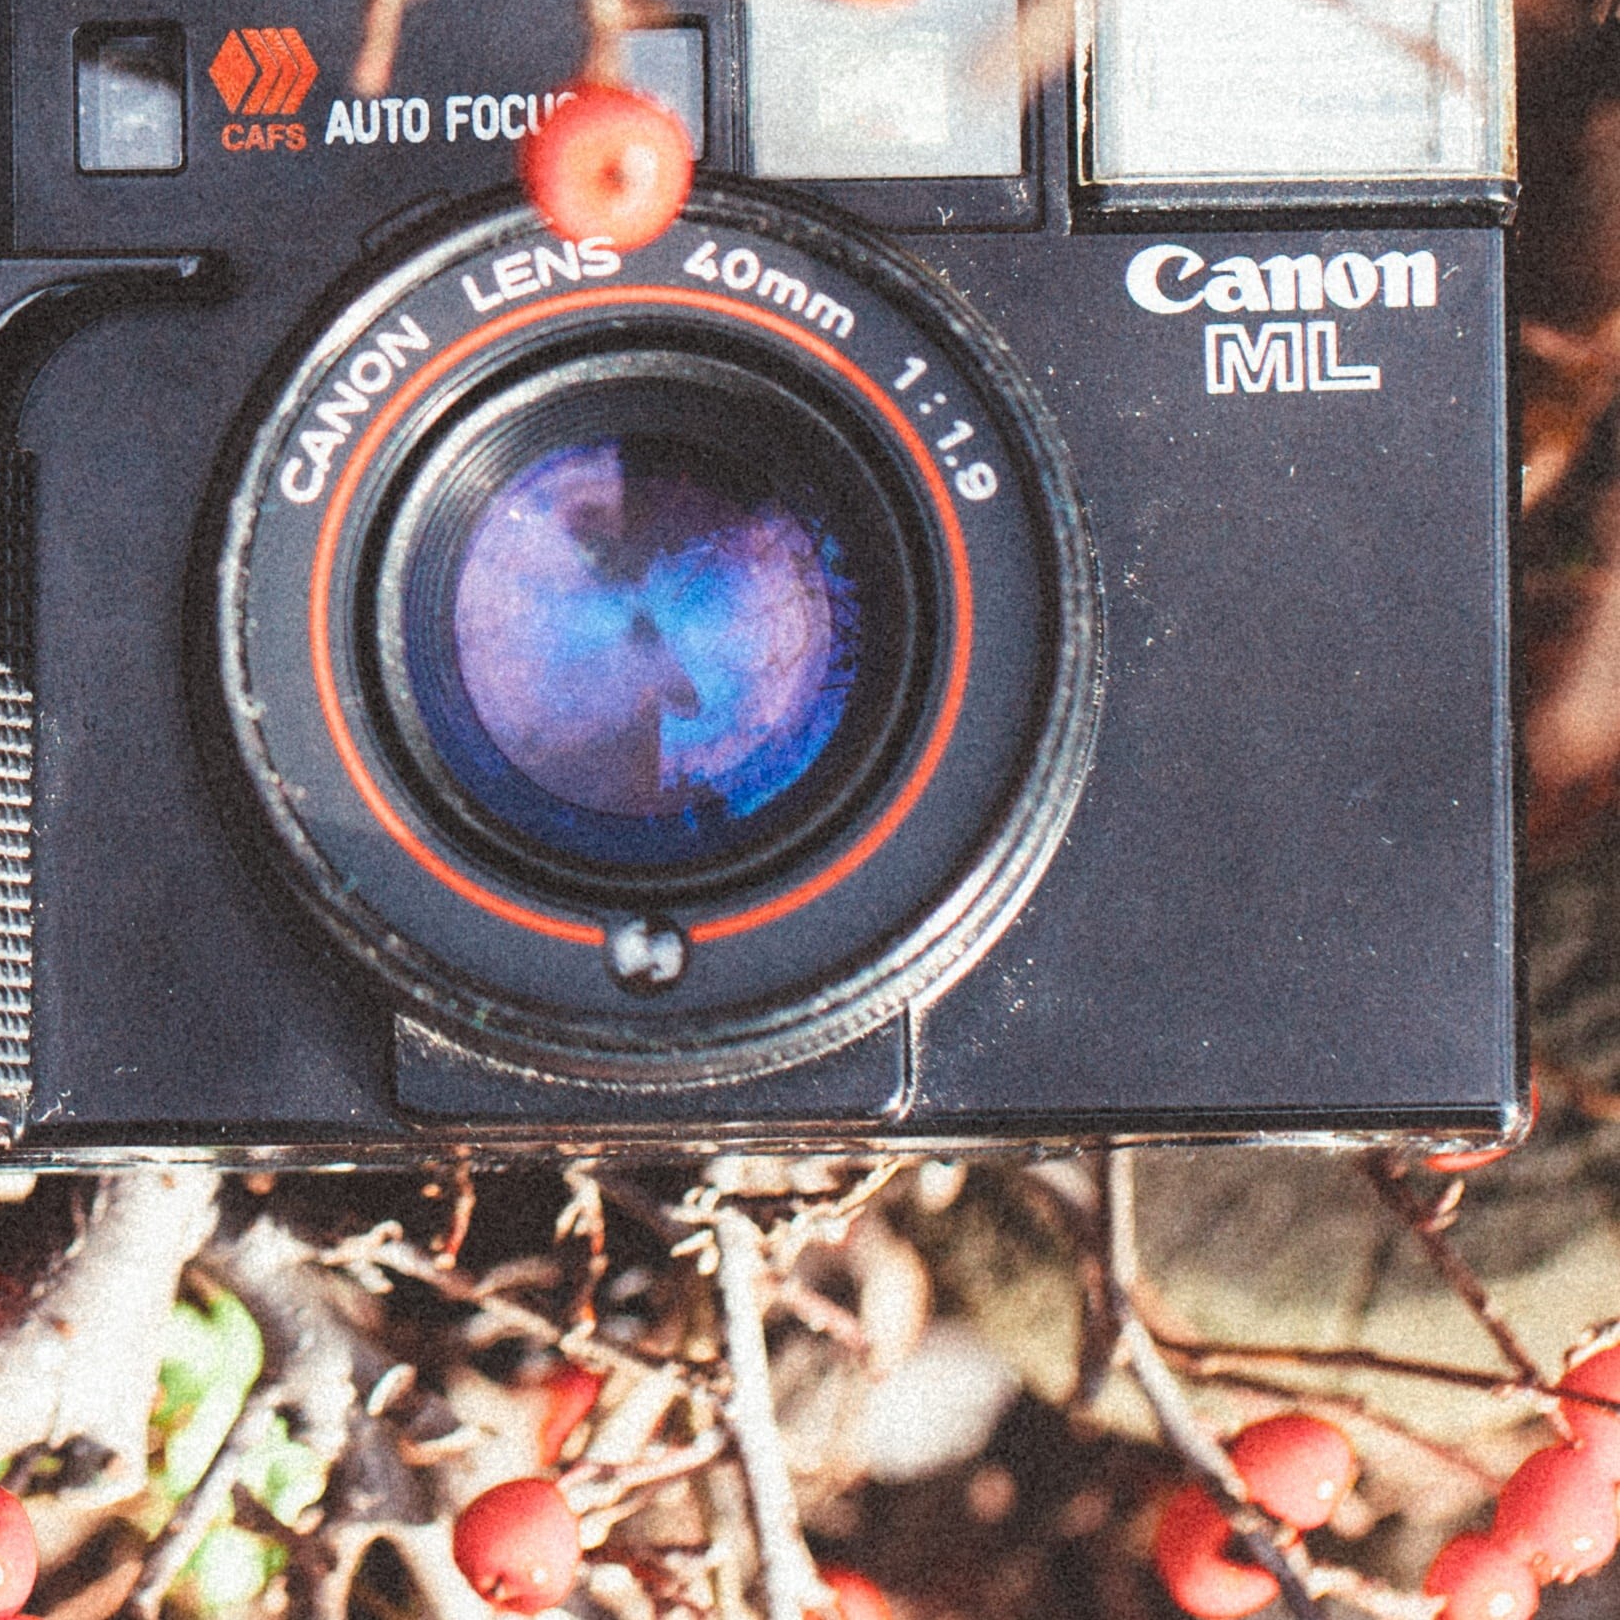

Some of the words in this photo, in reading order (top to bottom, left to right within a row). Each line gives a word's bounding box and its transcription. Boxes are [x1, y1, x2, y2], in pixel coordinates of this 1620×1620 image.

[220, 122, 309, 152] CAFS
[324, 97, 430, 145] AUTO
[445, 91, 579, 143] FOCU
[1125, 243, 1439, 315] Canon
[280, 314, 431, 503] CANON
[461, 236, 622, 312] LENS
[683, 240, 855, 338] 40mm
[1204, 320, 1381, 395] ML
